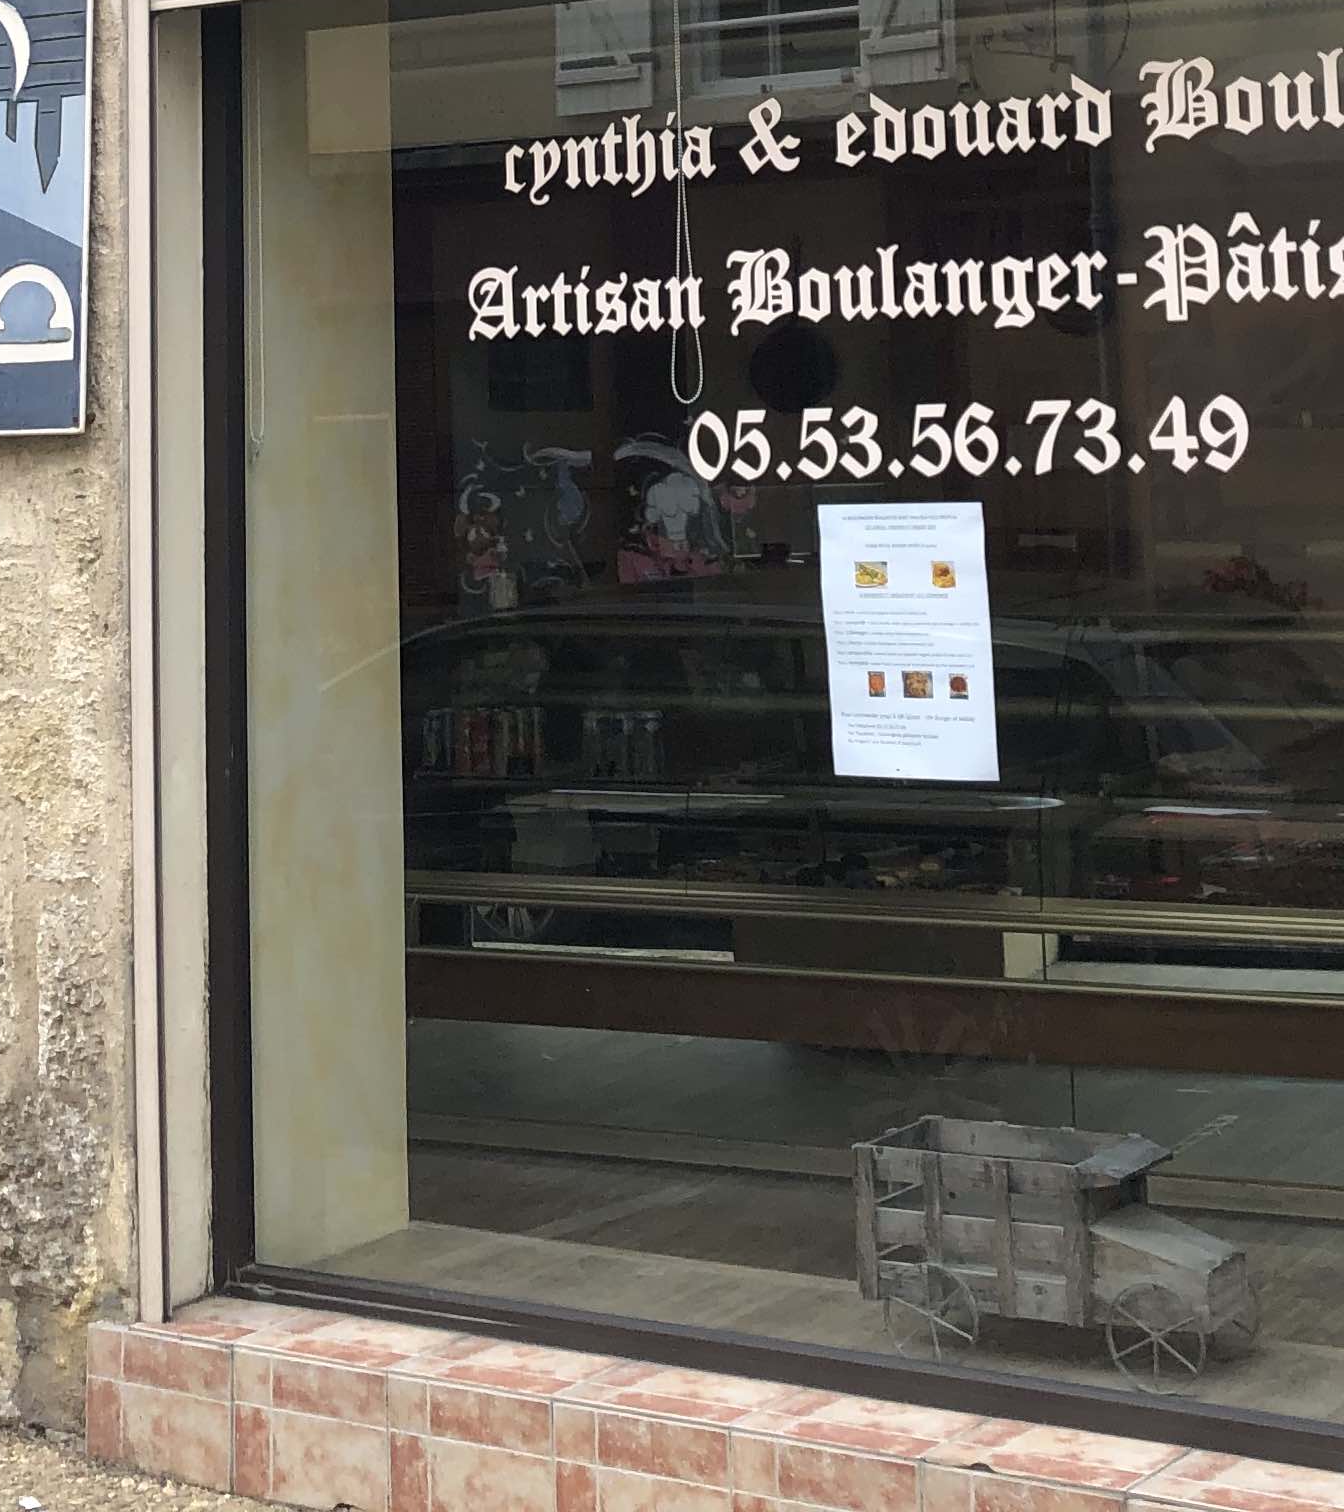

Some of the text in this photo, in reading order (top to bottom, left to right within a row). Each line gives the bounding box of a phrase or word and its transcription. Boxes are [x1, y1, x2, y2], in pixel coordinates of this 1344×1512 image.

[738, 96, 802, 175] &
[834, 73, 1113, 168] edouard
[467, 265, 707, 342] Artisan
[687, 394, 1250, 482] 05.53.56.73.49
